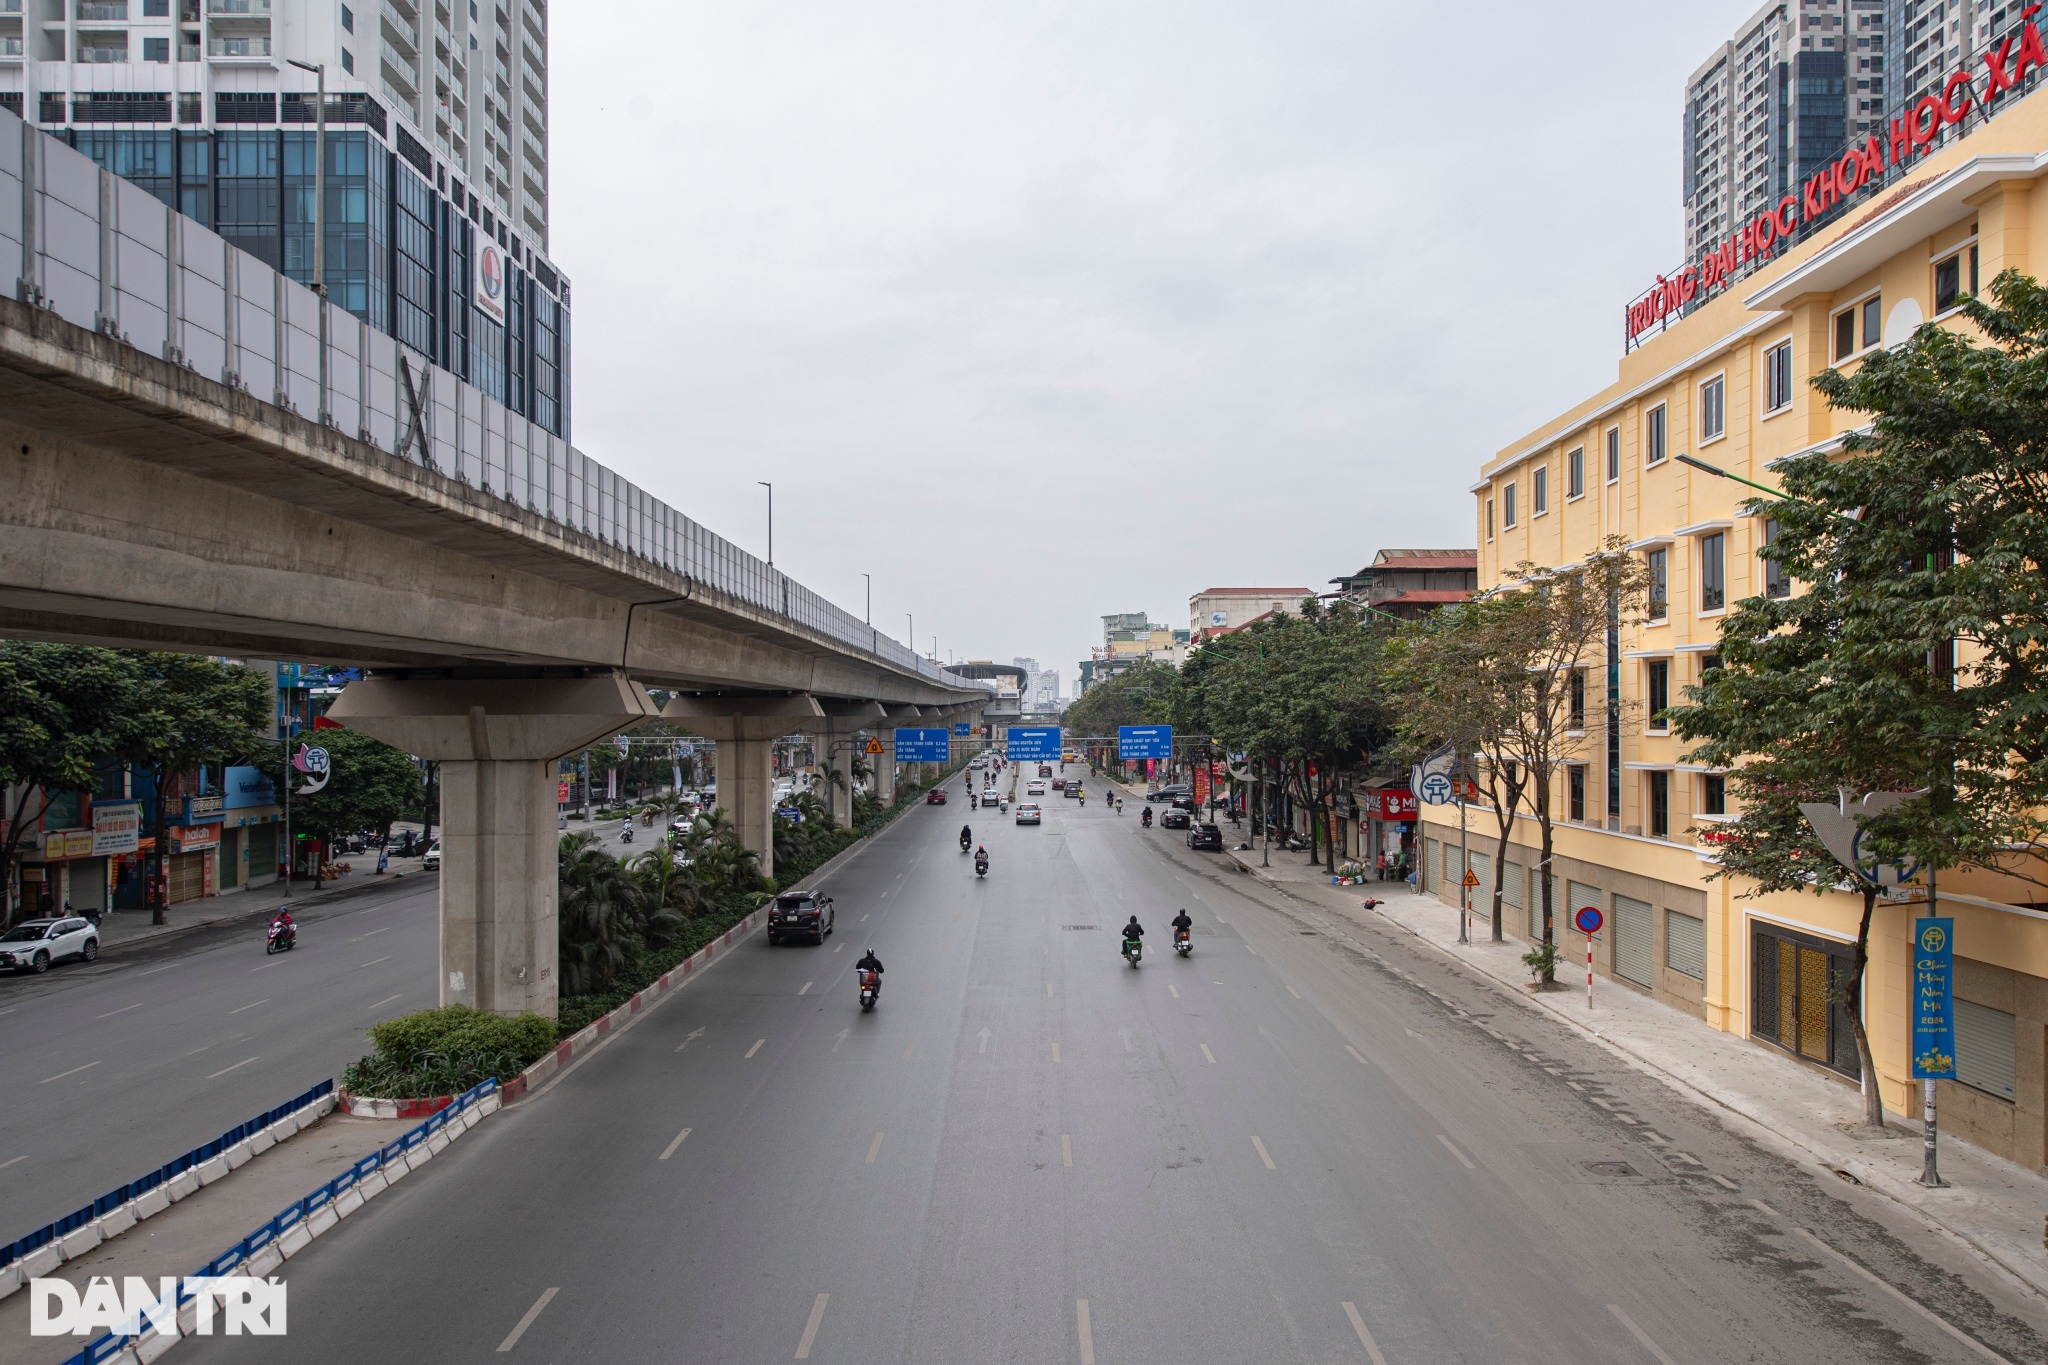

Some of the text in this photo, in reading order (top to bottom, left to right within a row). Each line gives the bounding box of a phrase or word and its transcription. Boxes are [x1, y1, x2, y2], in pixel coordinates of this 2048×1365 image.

[1702, 235, 1737, 291] ĐẠI
[1742, 195, 1797, 261] HỌC
[1804, 136, 1885, 222] KHOA
[1890, 71, 1972, 165] HỌC
[1984, 3, 2048, 103] XÃ
[1917, 960, 1947, 970] Chúc
[1919, 972, 1945, 990] Mừng
[1921, 986, 1943, 997] Năm
[1923, 1000, 1941, 1012] Mới
